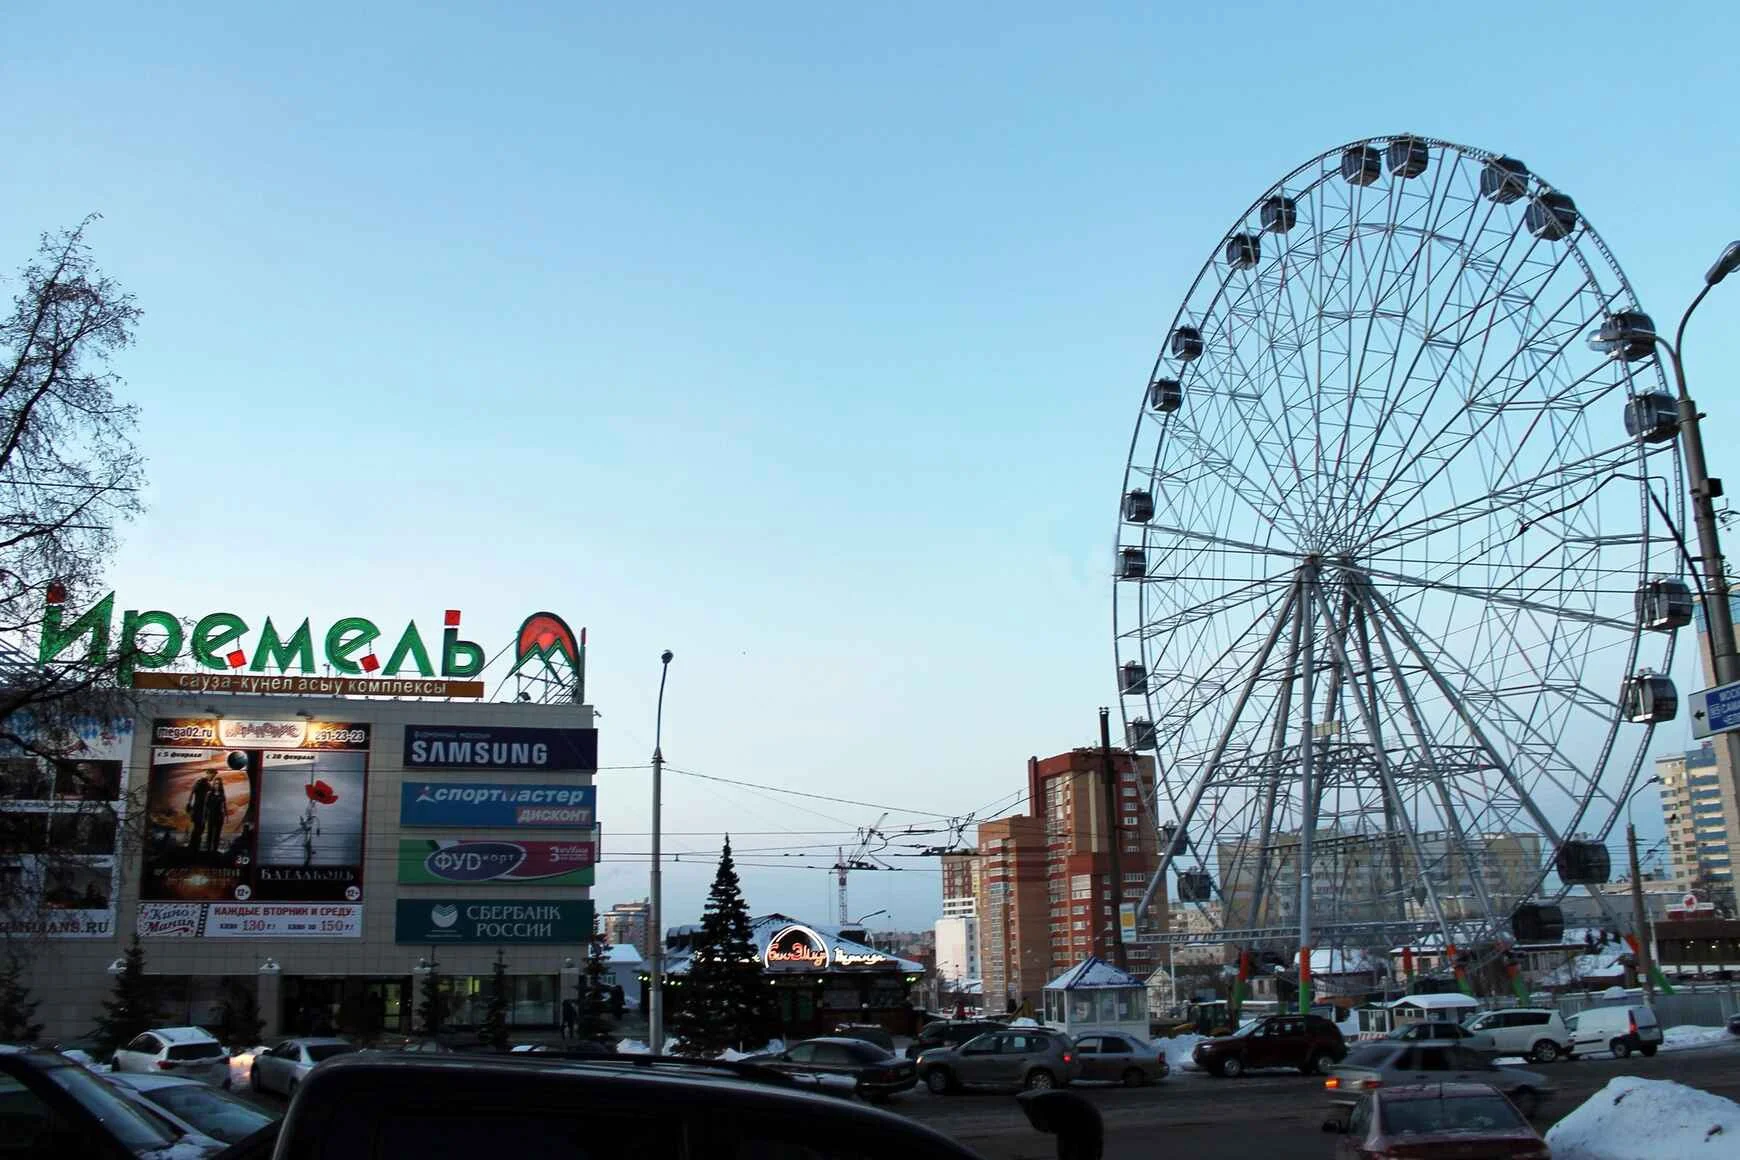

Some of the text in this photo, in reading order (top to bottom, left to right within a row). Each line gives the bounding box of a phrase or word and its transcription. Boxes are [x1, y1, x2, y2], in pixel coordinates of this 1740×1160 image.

[298, 678, 343, 695] асыу
[348, 680, 447, 695] комплексы
[158, 726, 213, 740] mega02.ru
[411, 740, 548, 765] SAMSUNG
[235, 855, 250, 865] 3D
[214, 906, 261, 917] КАЖДЫЕ
[263, 907, 308, 917] ВТОРНИК
[466, 905, 561, 921] СБЕРБАНК
[242, 920, 266, 931] 130
[321, 920, 344, 932] 150
[476, 922, 552, 937] РОССИИ
